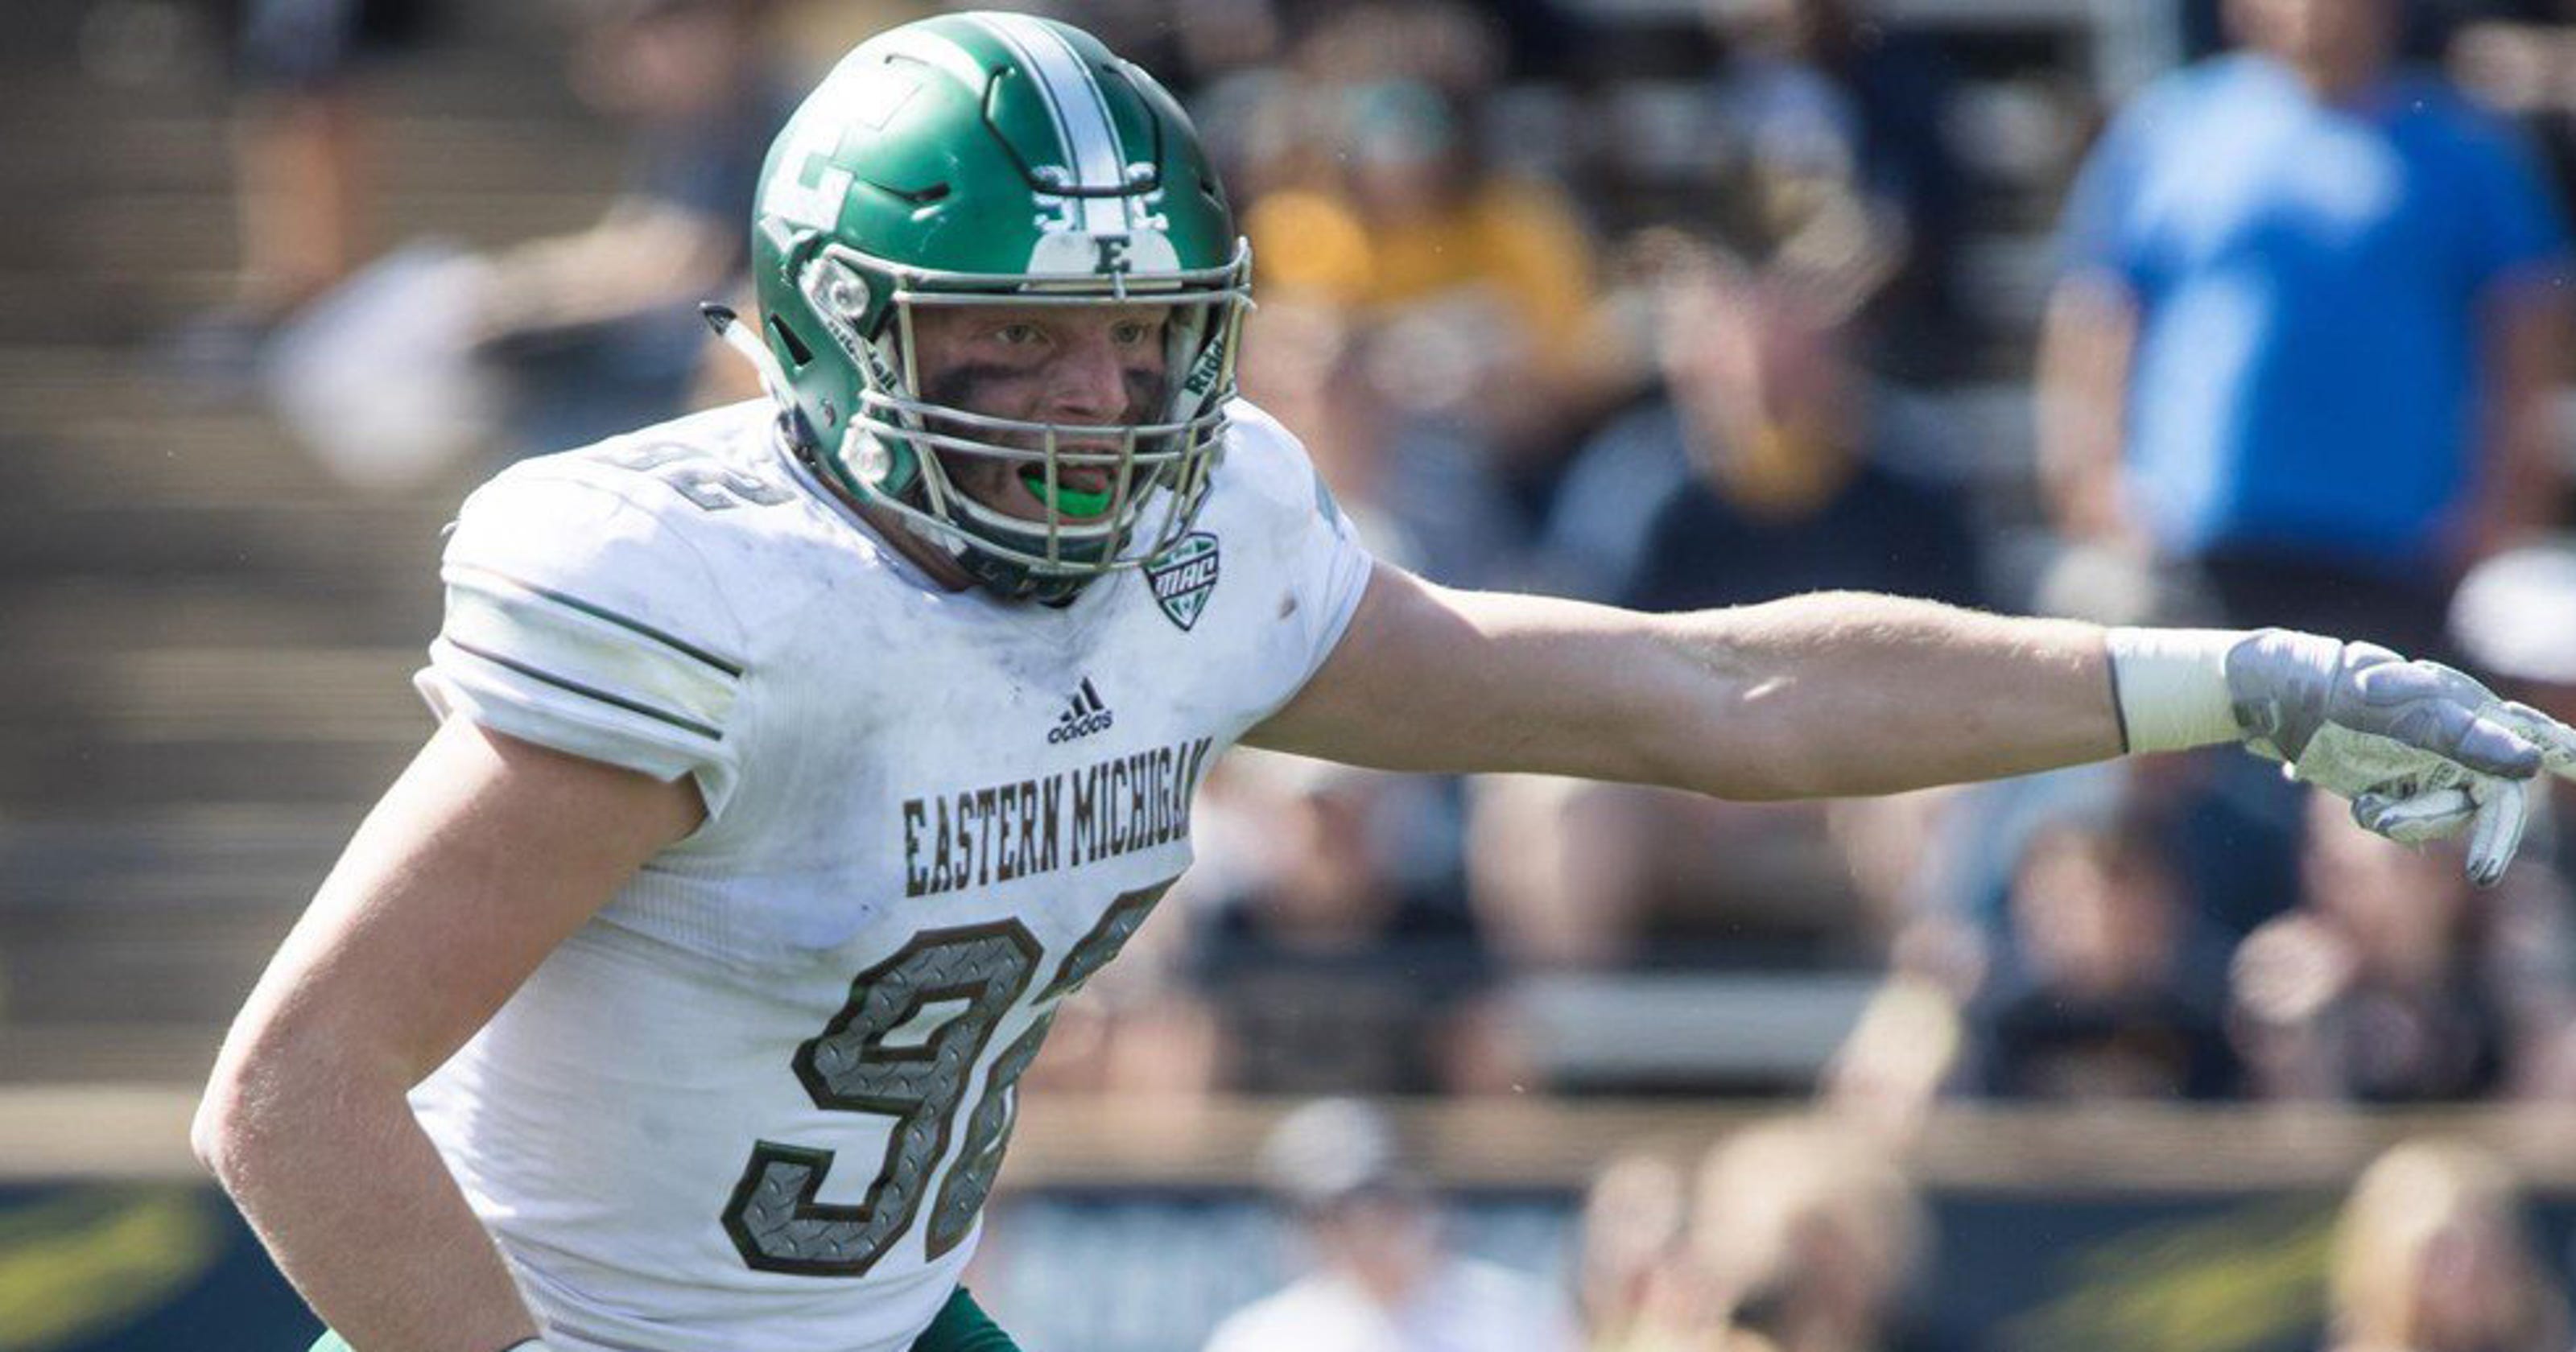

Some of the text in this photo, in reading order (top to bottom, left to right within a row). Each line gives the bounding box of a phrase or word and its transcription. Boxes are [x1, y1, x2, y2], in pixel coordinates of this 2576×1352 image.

[1096, 235, 1131, 274] E
[1154, 556, 1218, 599] MAC
[1047, 710, 1113, 744] adidas
[903, 773, 1063, 898] EASTERN
